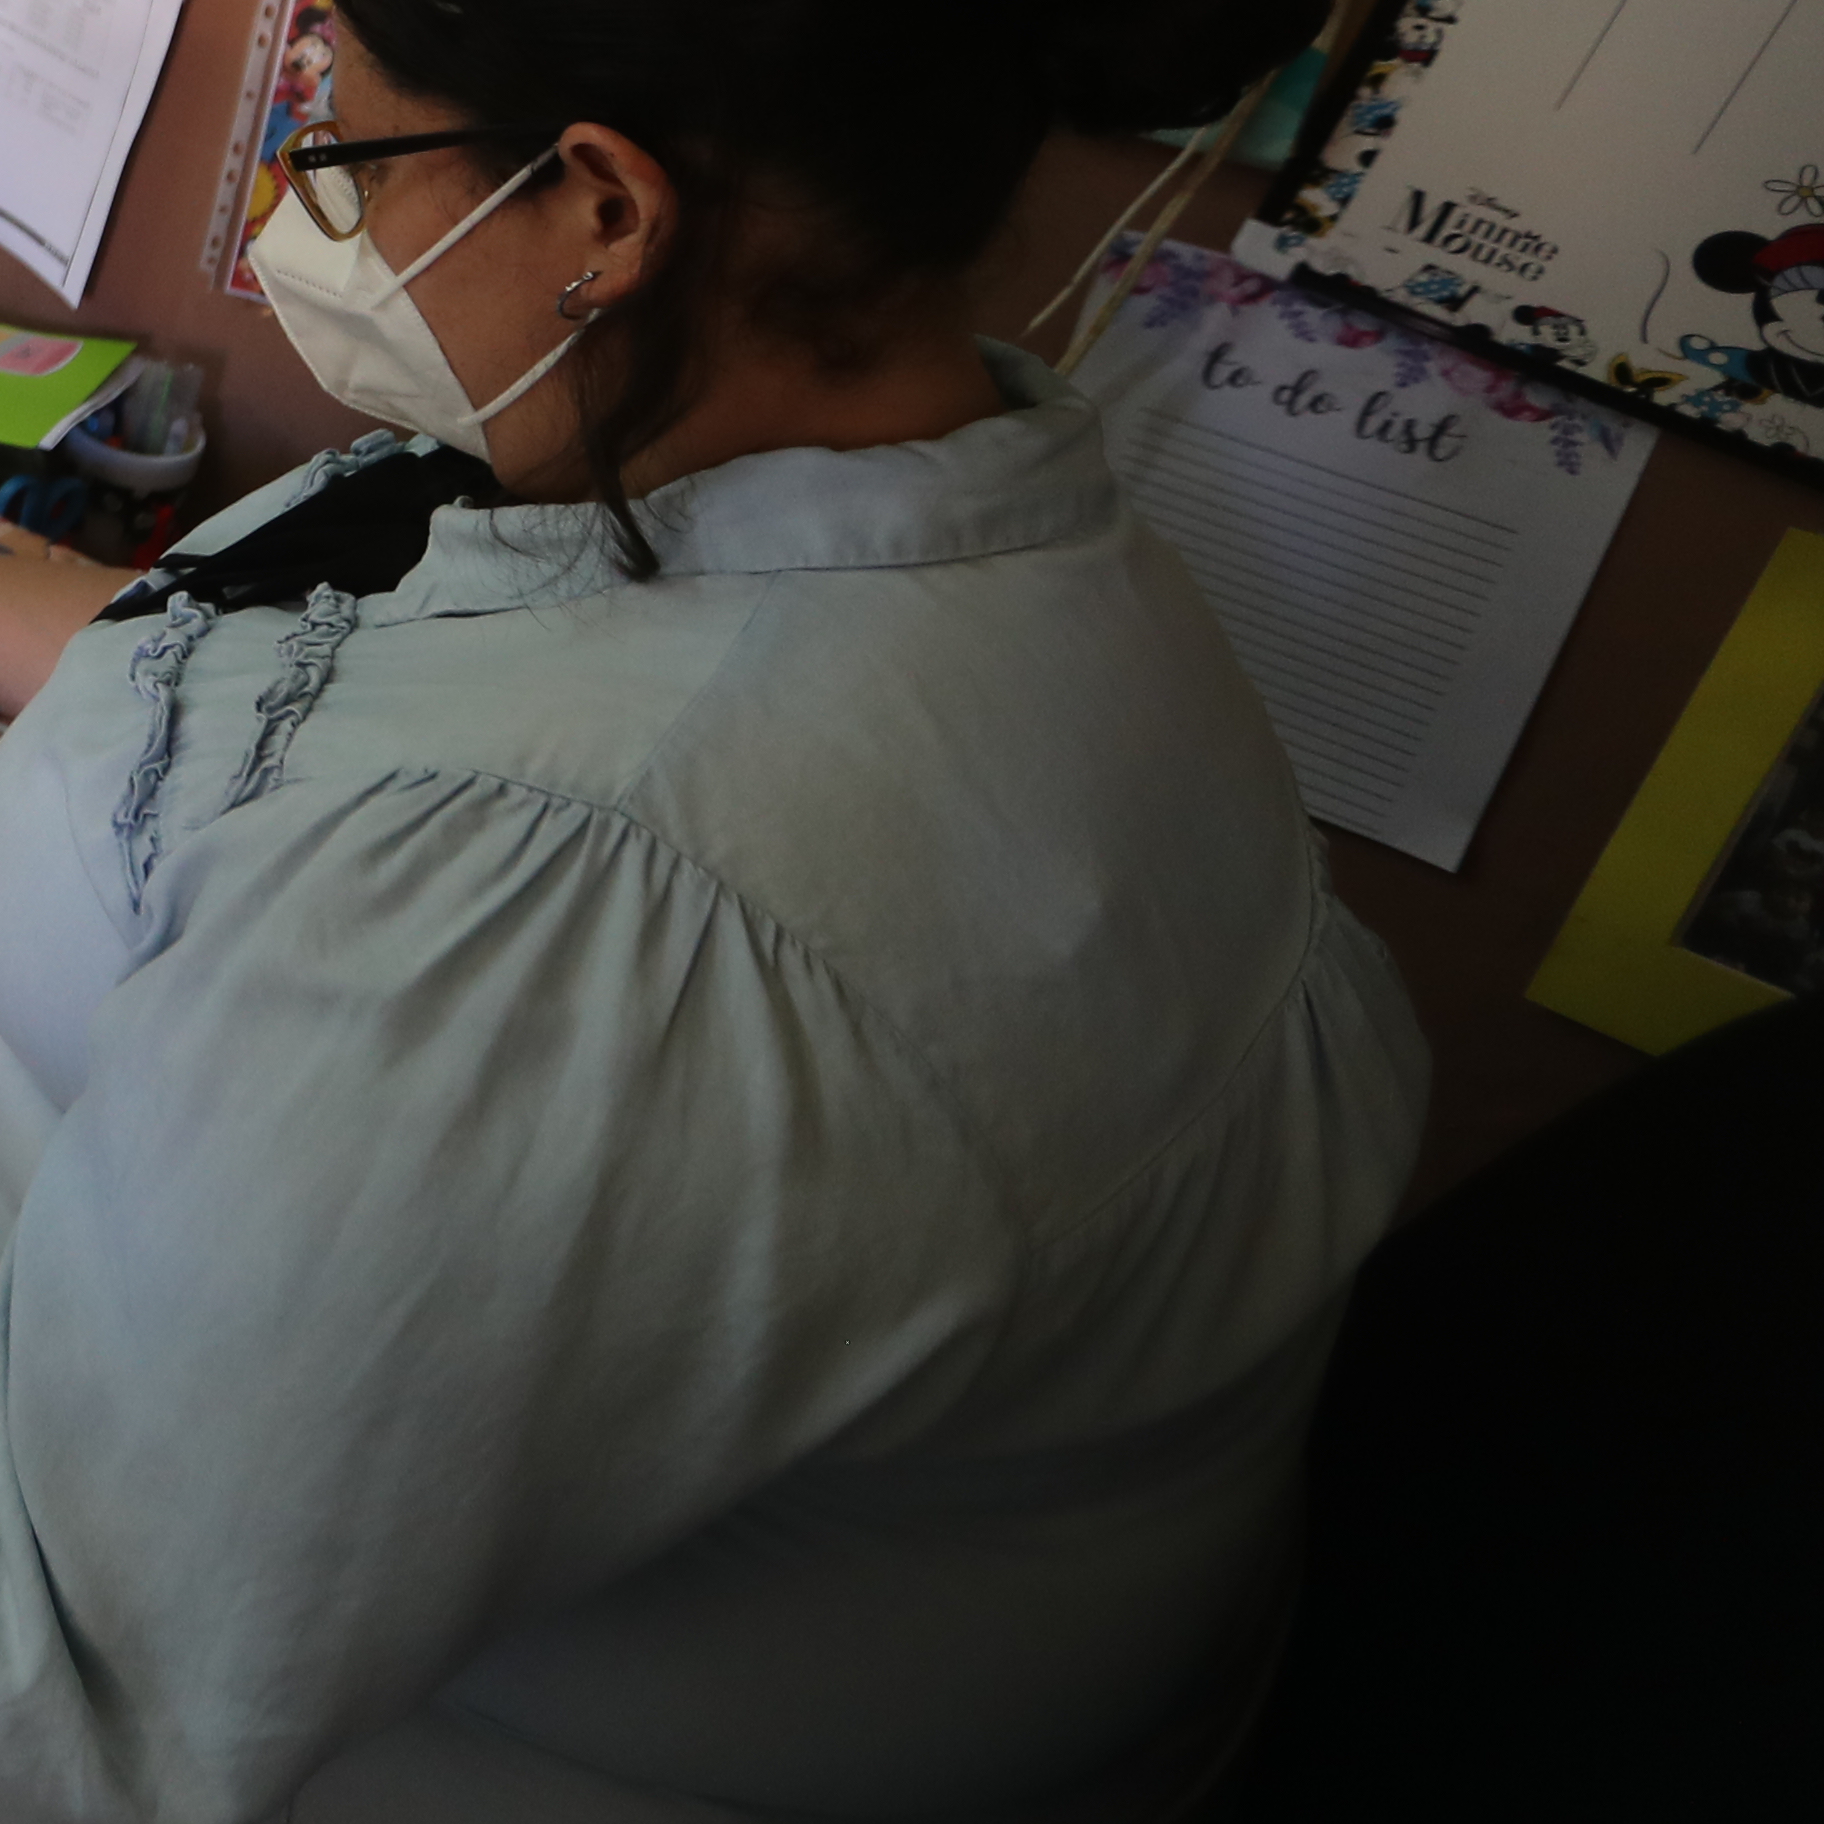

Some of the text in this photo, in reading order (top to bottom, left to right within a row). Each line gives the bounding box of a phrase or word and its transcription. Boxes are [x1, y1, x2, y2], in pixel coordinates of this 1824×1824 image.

[1388, 186, 1558, 262] Minnie
[1202, 342, 1467, 462] to do list
